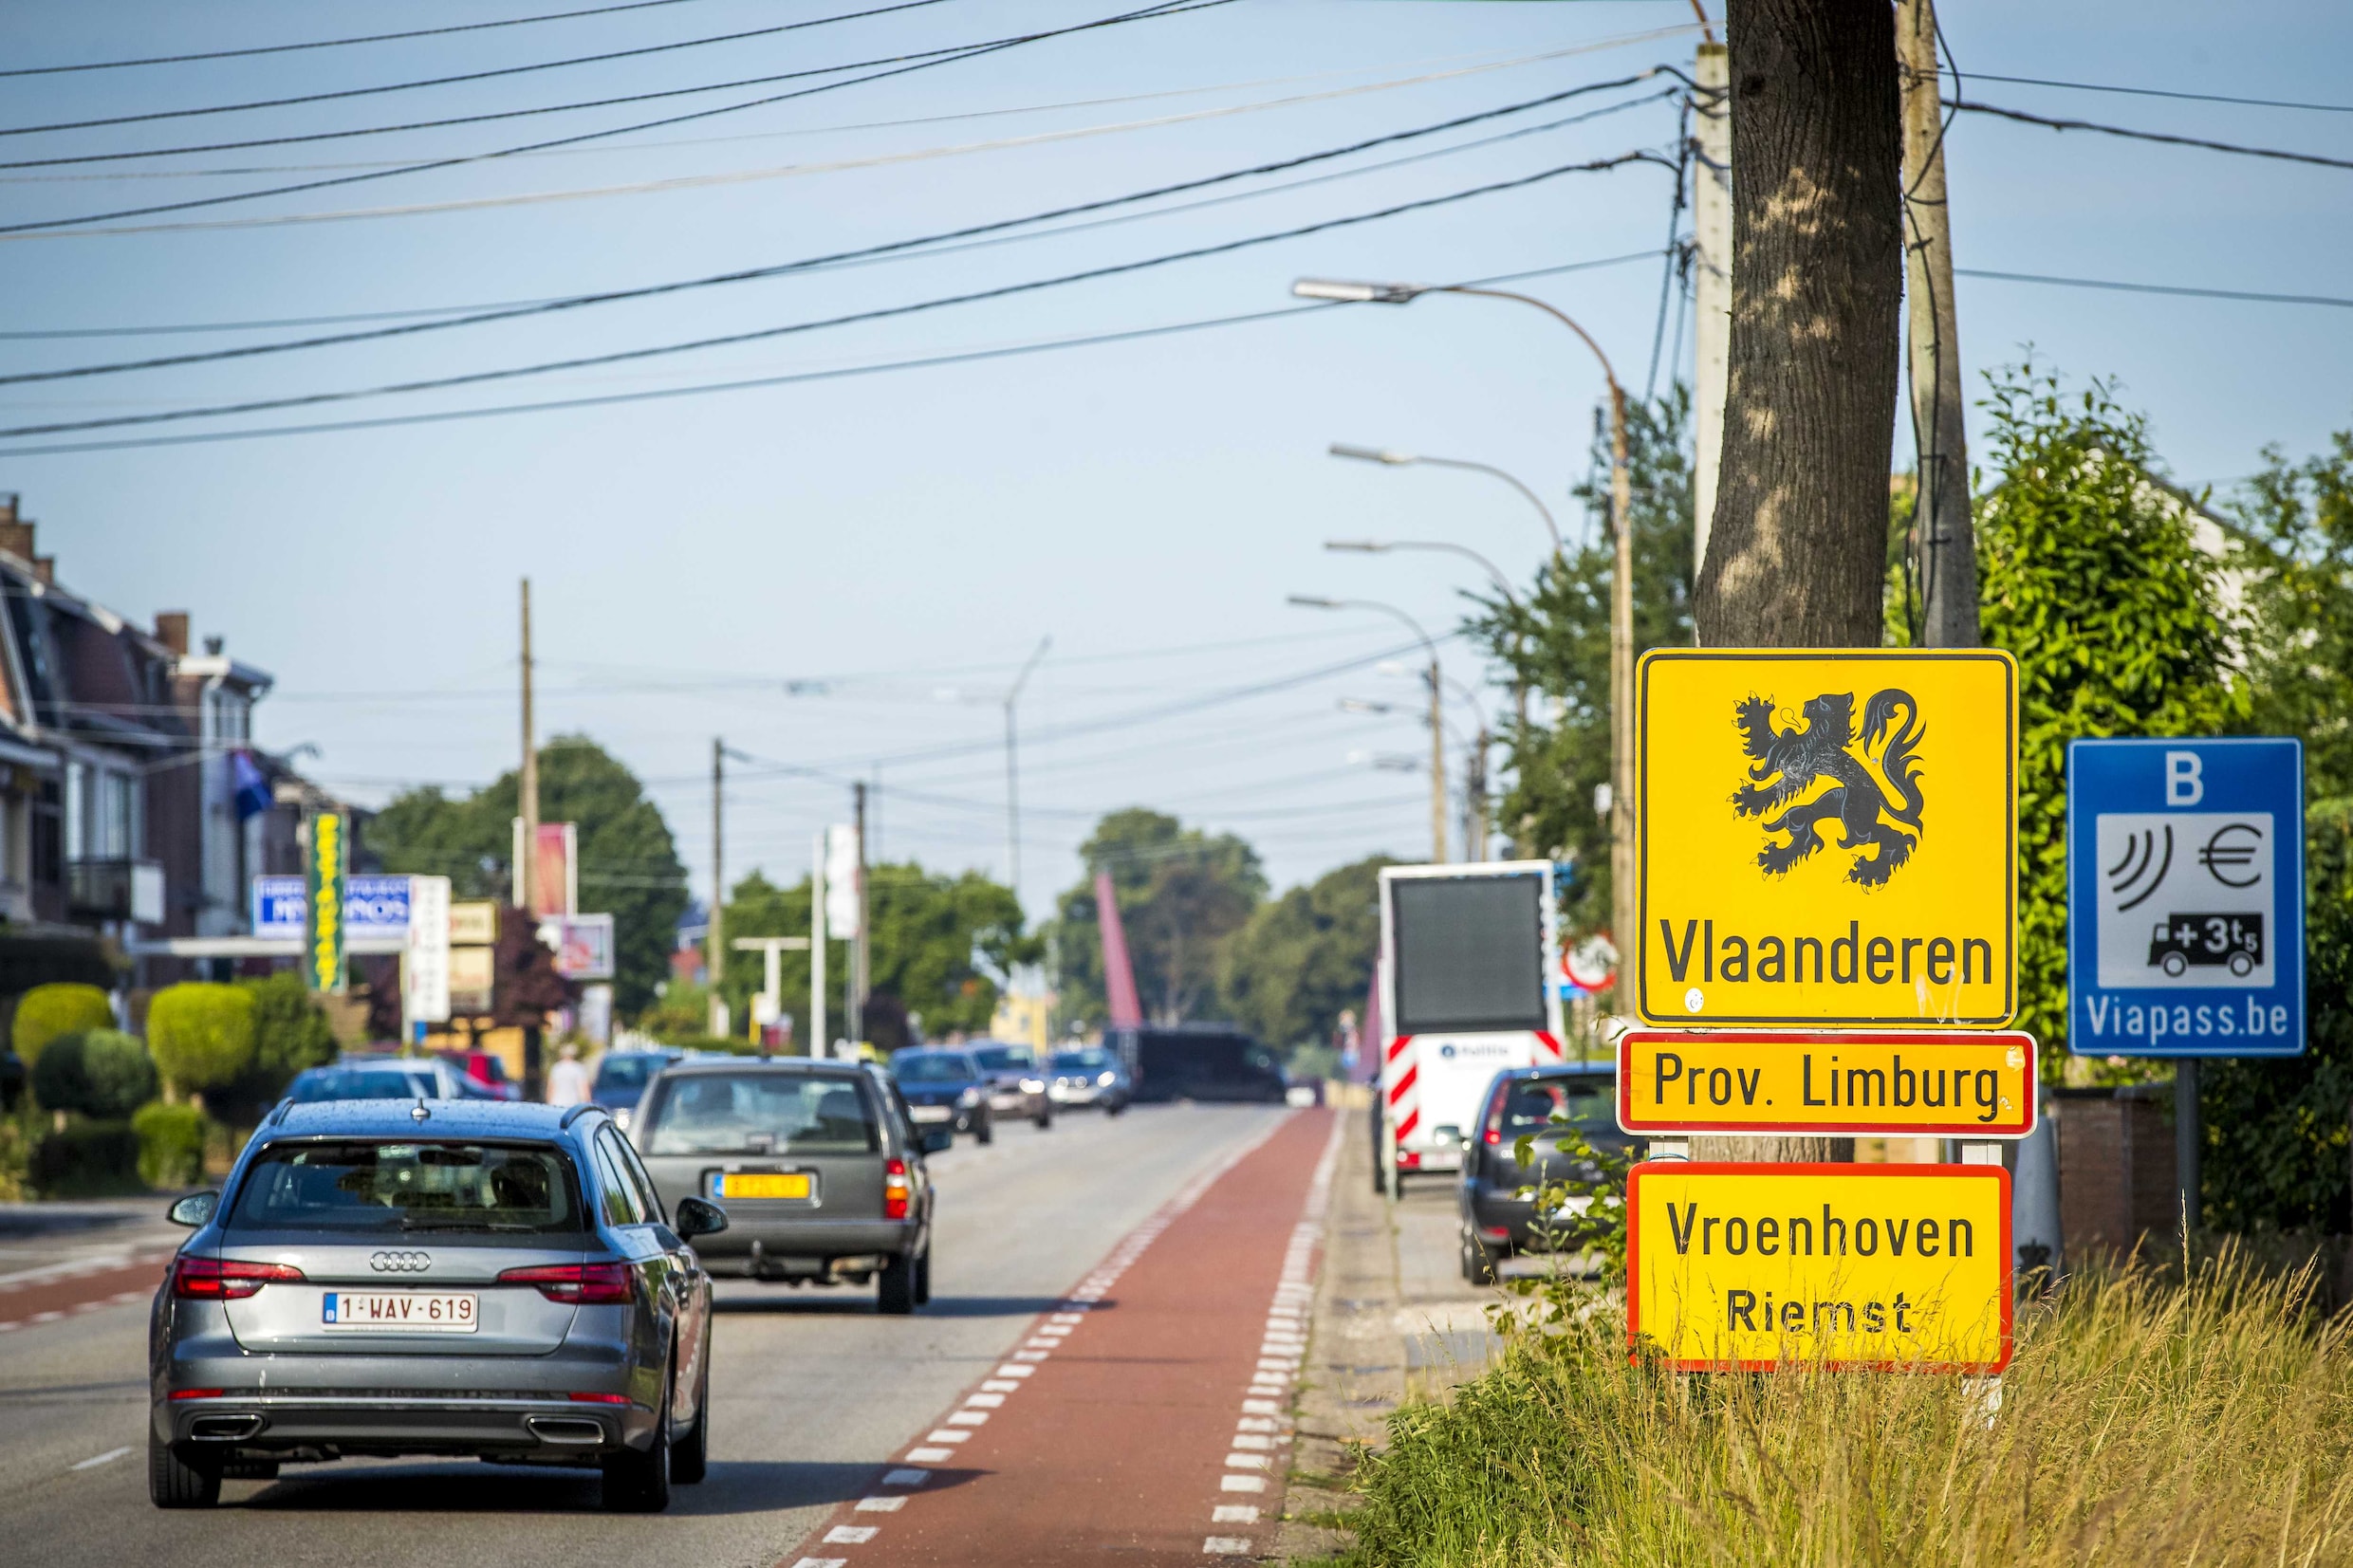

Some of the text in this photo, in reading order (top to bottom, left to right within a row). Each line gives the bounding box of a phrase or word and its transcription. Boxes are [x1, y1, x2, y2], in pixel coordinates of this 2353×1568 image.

[2165, 750, 2204, 806] B
[1660, 919, 1992, 985] Vlaanderen
[2085, 994, 2288, 1046] Viapass.be
[1655, 1052, 1999, 1122] Prov. Limburg
[1666, 1202, 1973, 1258] Vroenhoven
[343, 1298, 472, 1319] 1-WAV-619
[1727, 1289, 1913, 1334] Riemst
